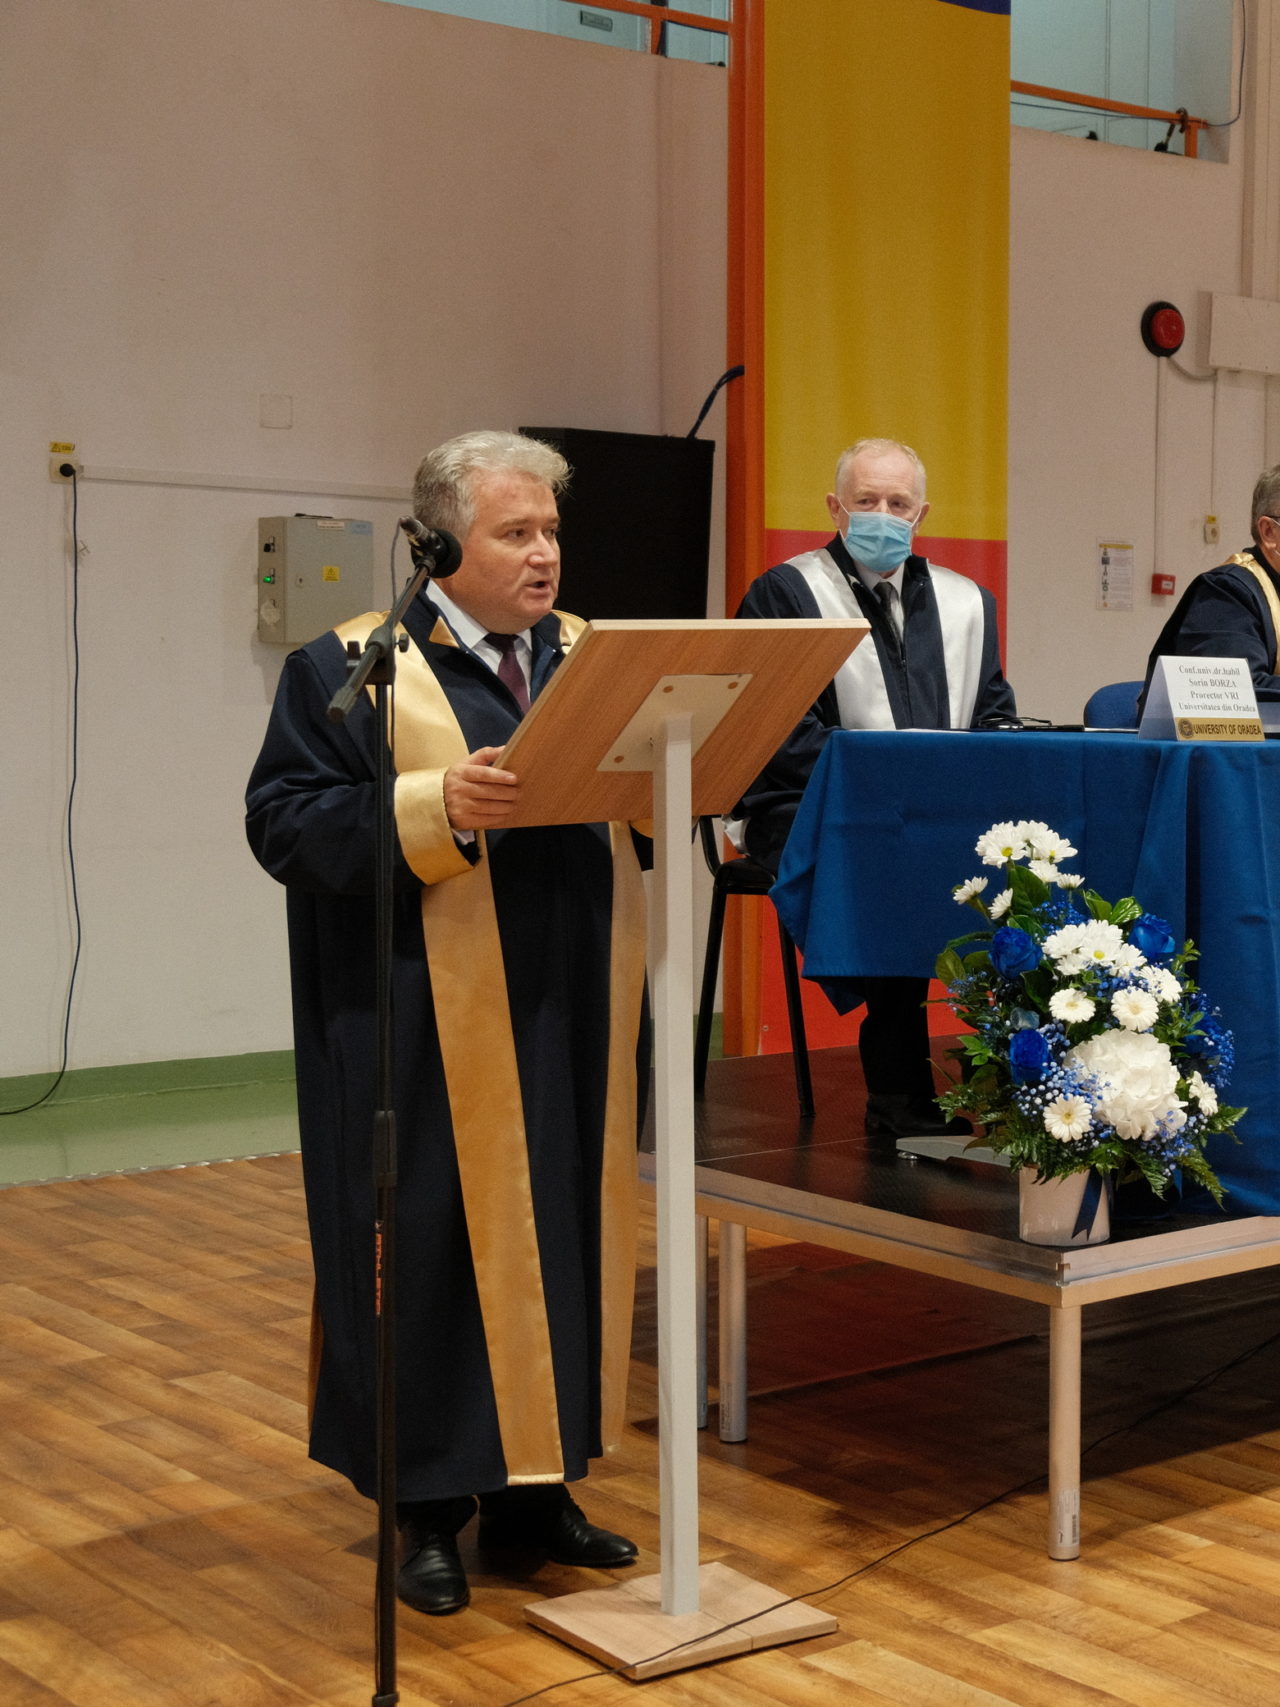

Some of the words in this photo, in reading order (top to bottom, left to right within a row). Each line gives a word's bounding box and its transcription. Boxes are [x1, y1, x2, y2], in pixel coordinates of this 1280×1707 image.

[1188, 679, 1208, 688] Sorin
[1209, 679, 1237, 688] BORZA
[1190, 690, 1223, 700] Prorector
[1224, 692, 1239, 700] VRI
[1178, 702, 1221, 711] Universitatea
[1222, 703, 1233, 712] din
[1233, 704, 1256, 712] Oradea
[1193, 723, 1228, 735] UNIVERSITY
[1228, 724, 1236, 735] OF
[1238, 724, 1262, 735] ORADEA
